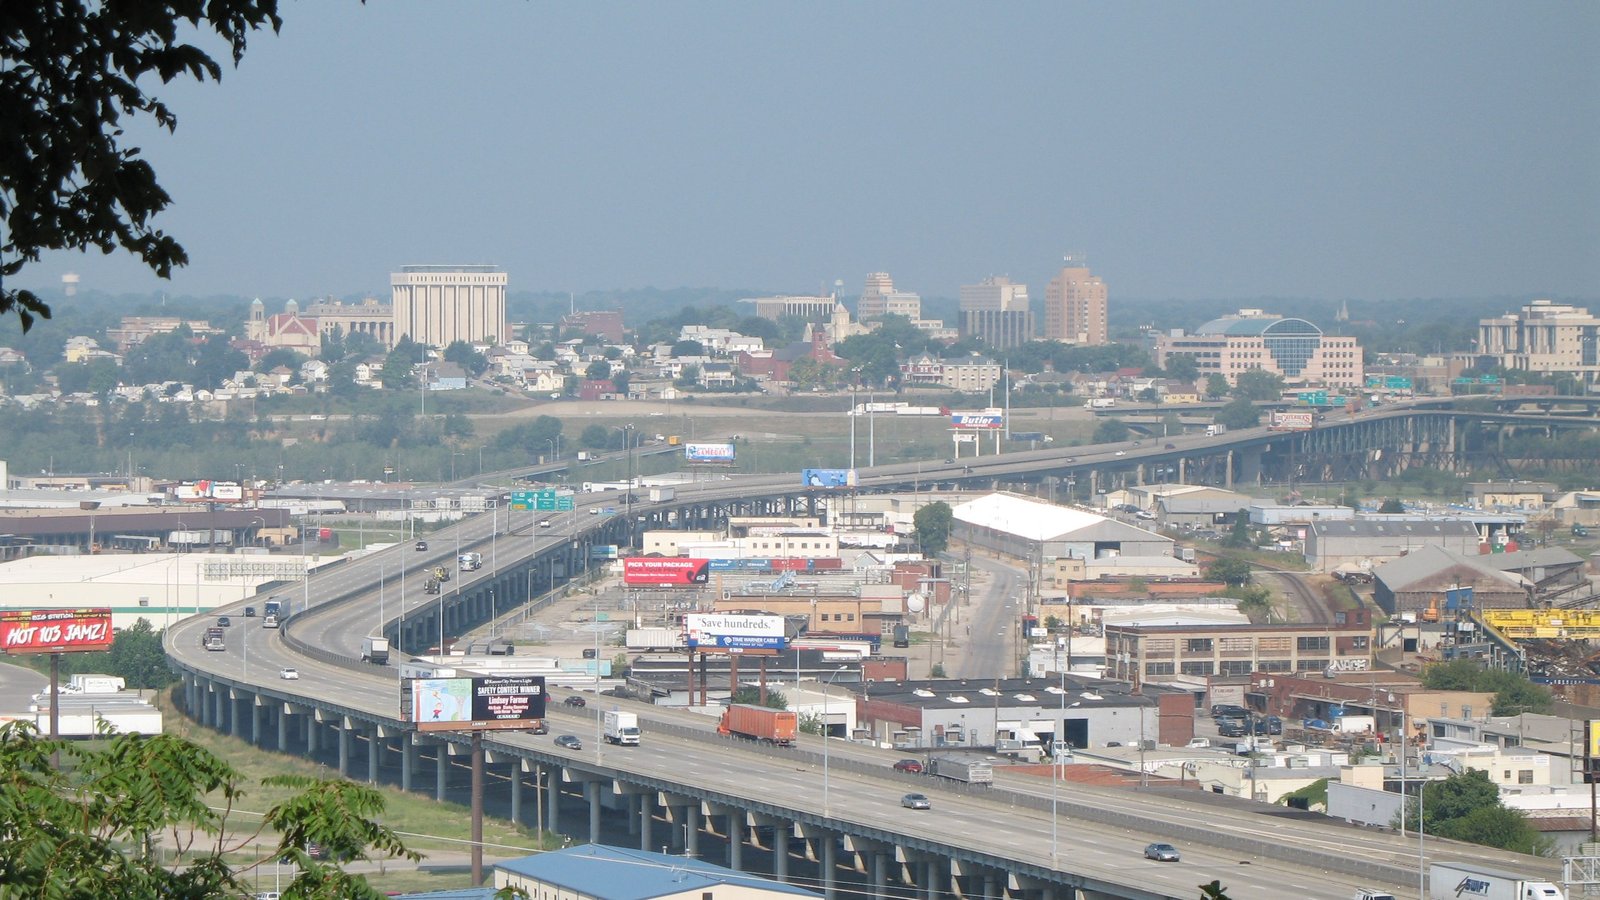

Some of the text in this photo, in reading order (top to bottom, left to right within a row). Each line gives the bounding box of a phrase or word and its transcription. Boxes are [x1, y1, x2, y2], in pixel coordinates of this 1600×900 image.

[960, 416, 994, 424] Butler
[7, 621, 108, 646] HOT 103 JAMZ!
[488, 696, 508, 705] Lindsey
[1465, 878, 1490, 894] SWIFT
